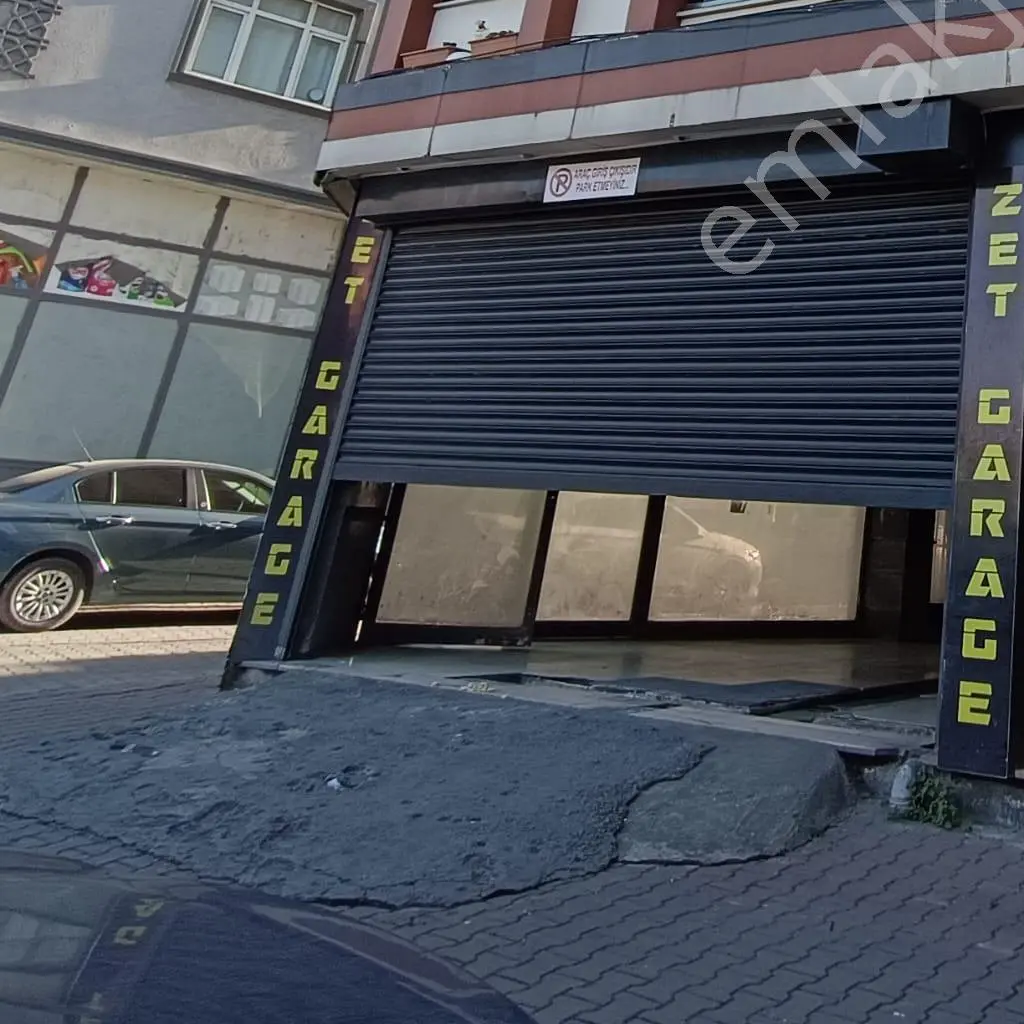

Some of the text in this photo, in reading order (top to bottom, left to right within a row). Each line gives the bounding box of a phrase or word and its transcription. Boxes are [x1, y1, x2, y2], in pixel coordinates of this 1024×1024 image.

[250, 360, 342, 626] GARAGE
[956, 183, 1023, 726] ZET GARAGE
